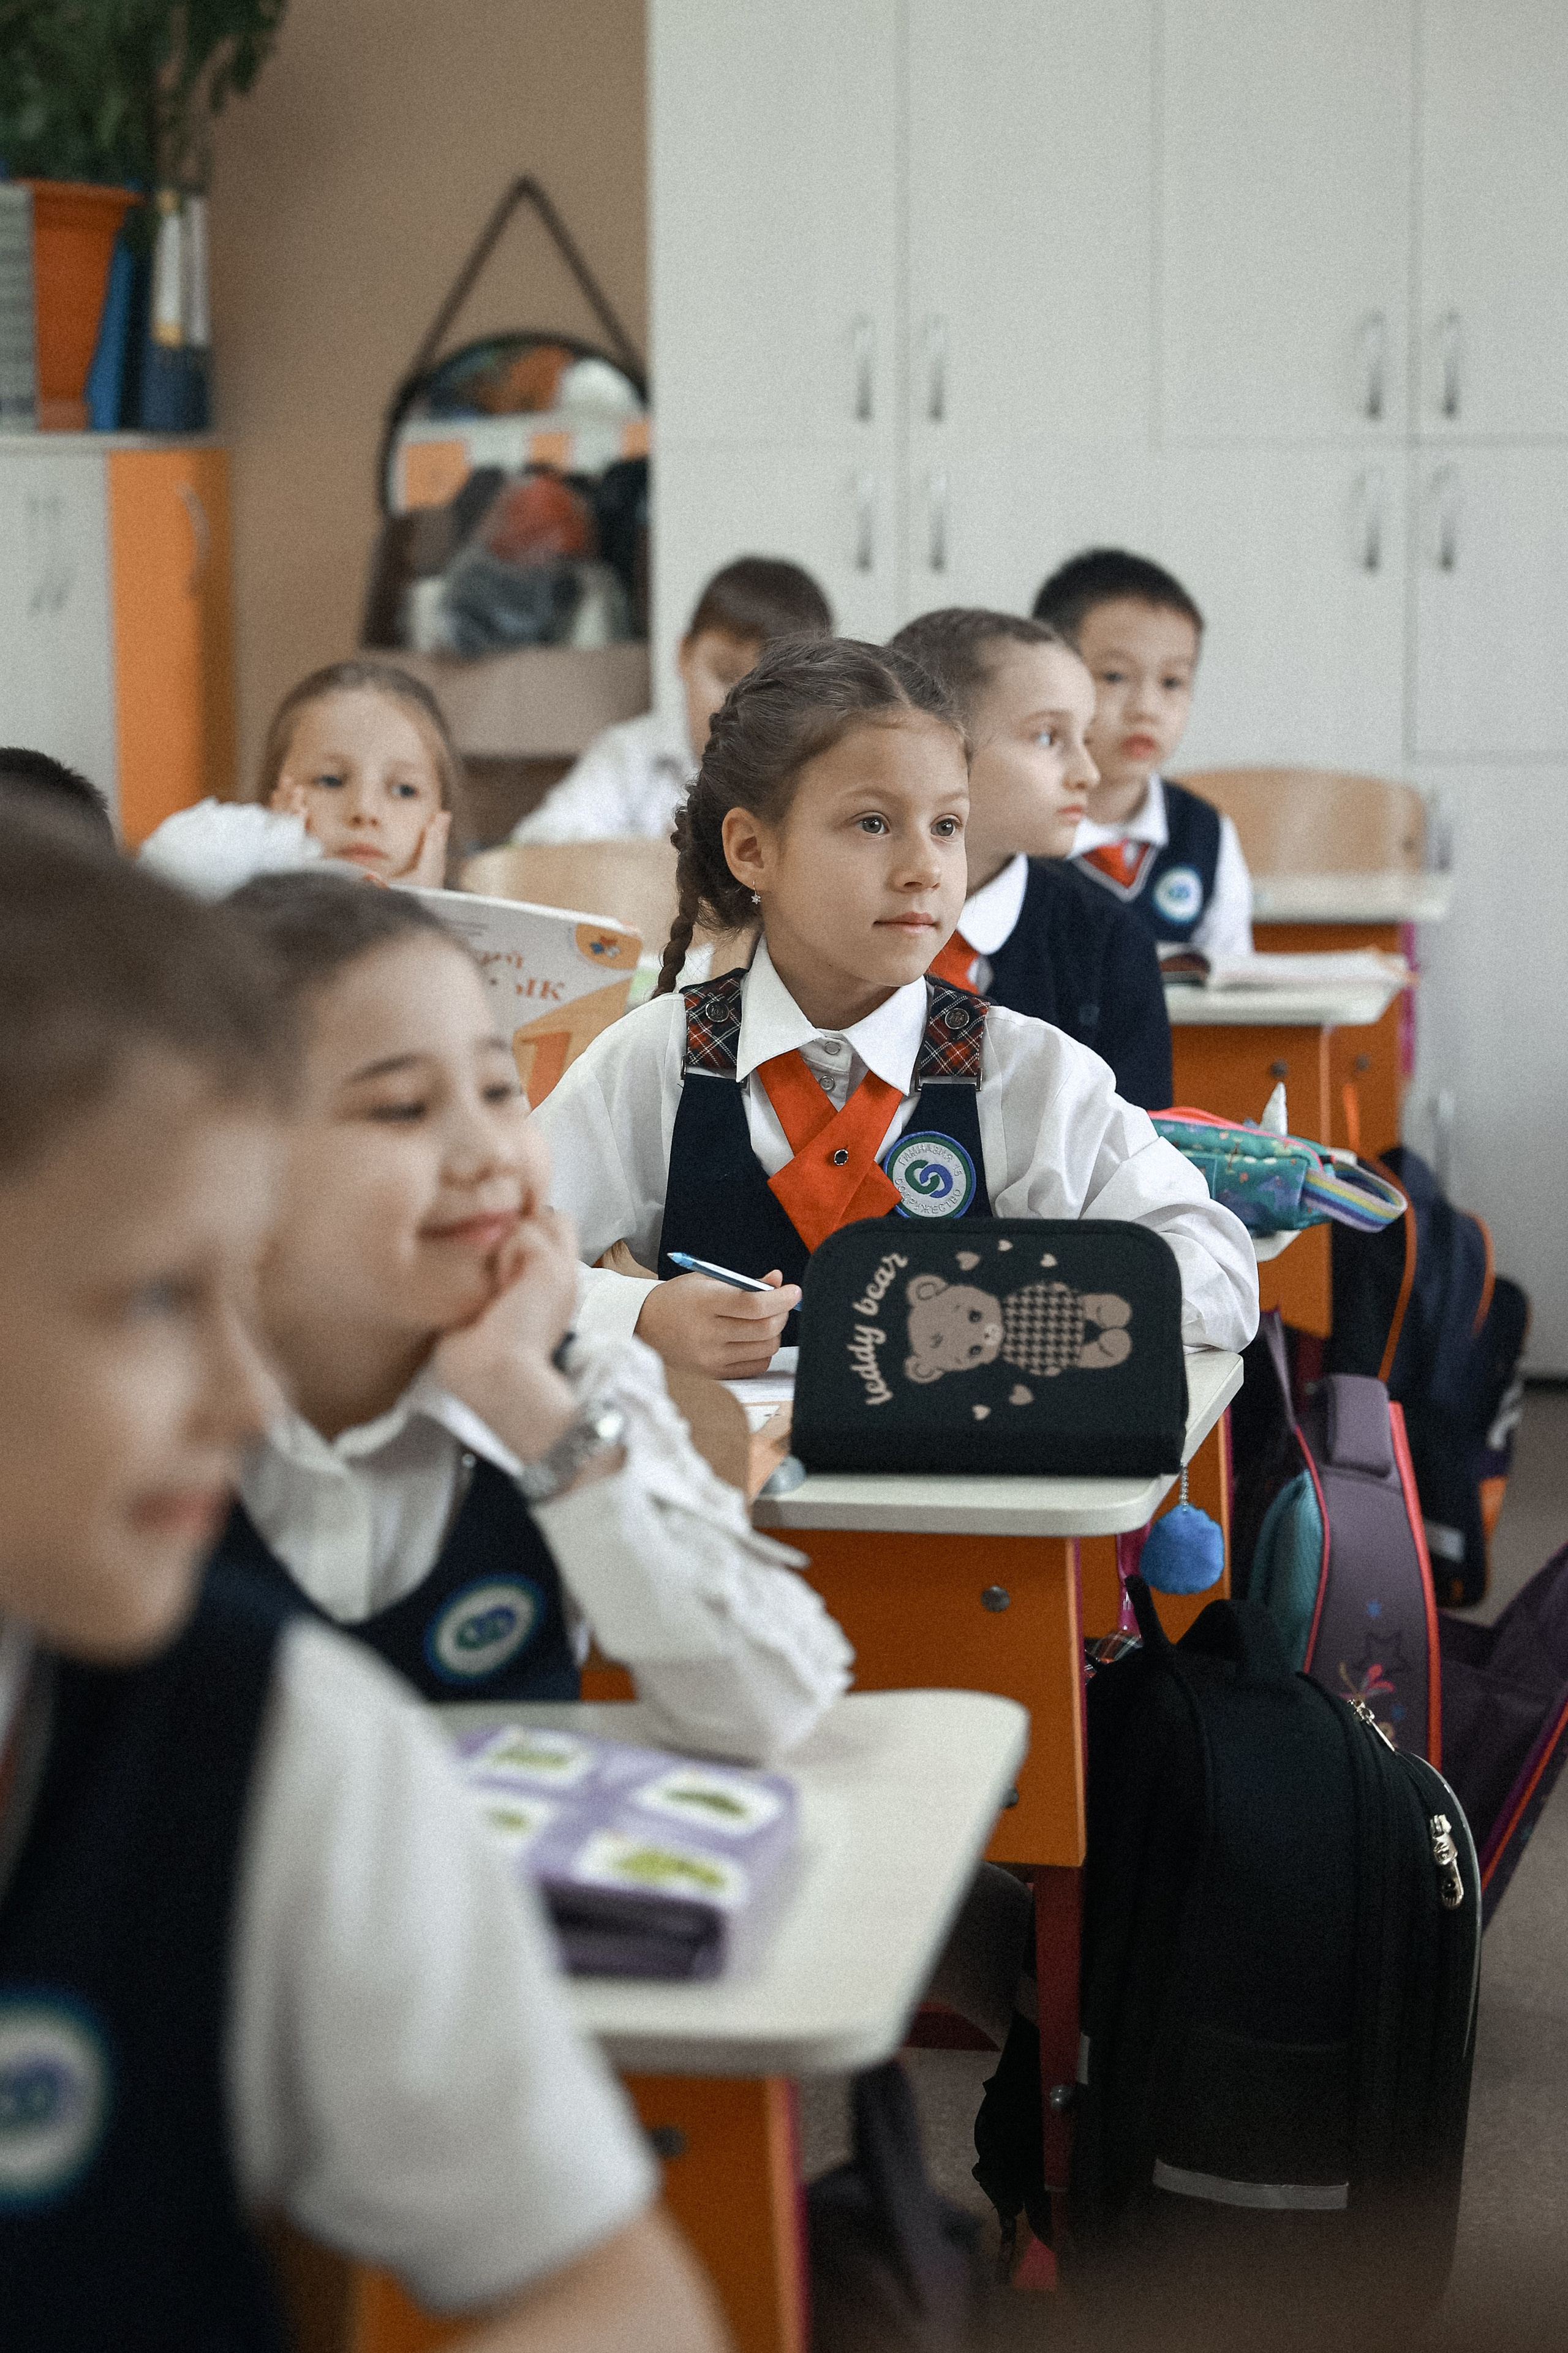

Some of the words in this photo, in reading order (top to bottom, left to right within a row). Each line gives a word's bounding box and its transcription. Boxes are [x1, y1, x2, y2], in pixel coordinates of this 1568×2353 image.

[898, 1143, 954, 1166] ГИМНАЗИЯ
[952, 1164, 963, 1176] 15
[895, 1177, 962, 1215] СОДРУЖЕСТВО
[852, 1252, 908, 1316] bear
